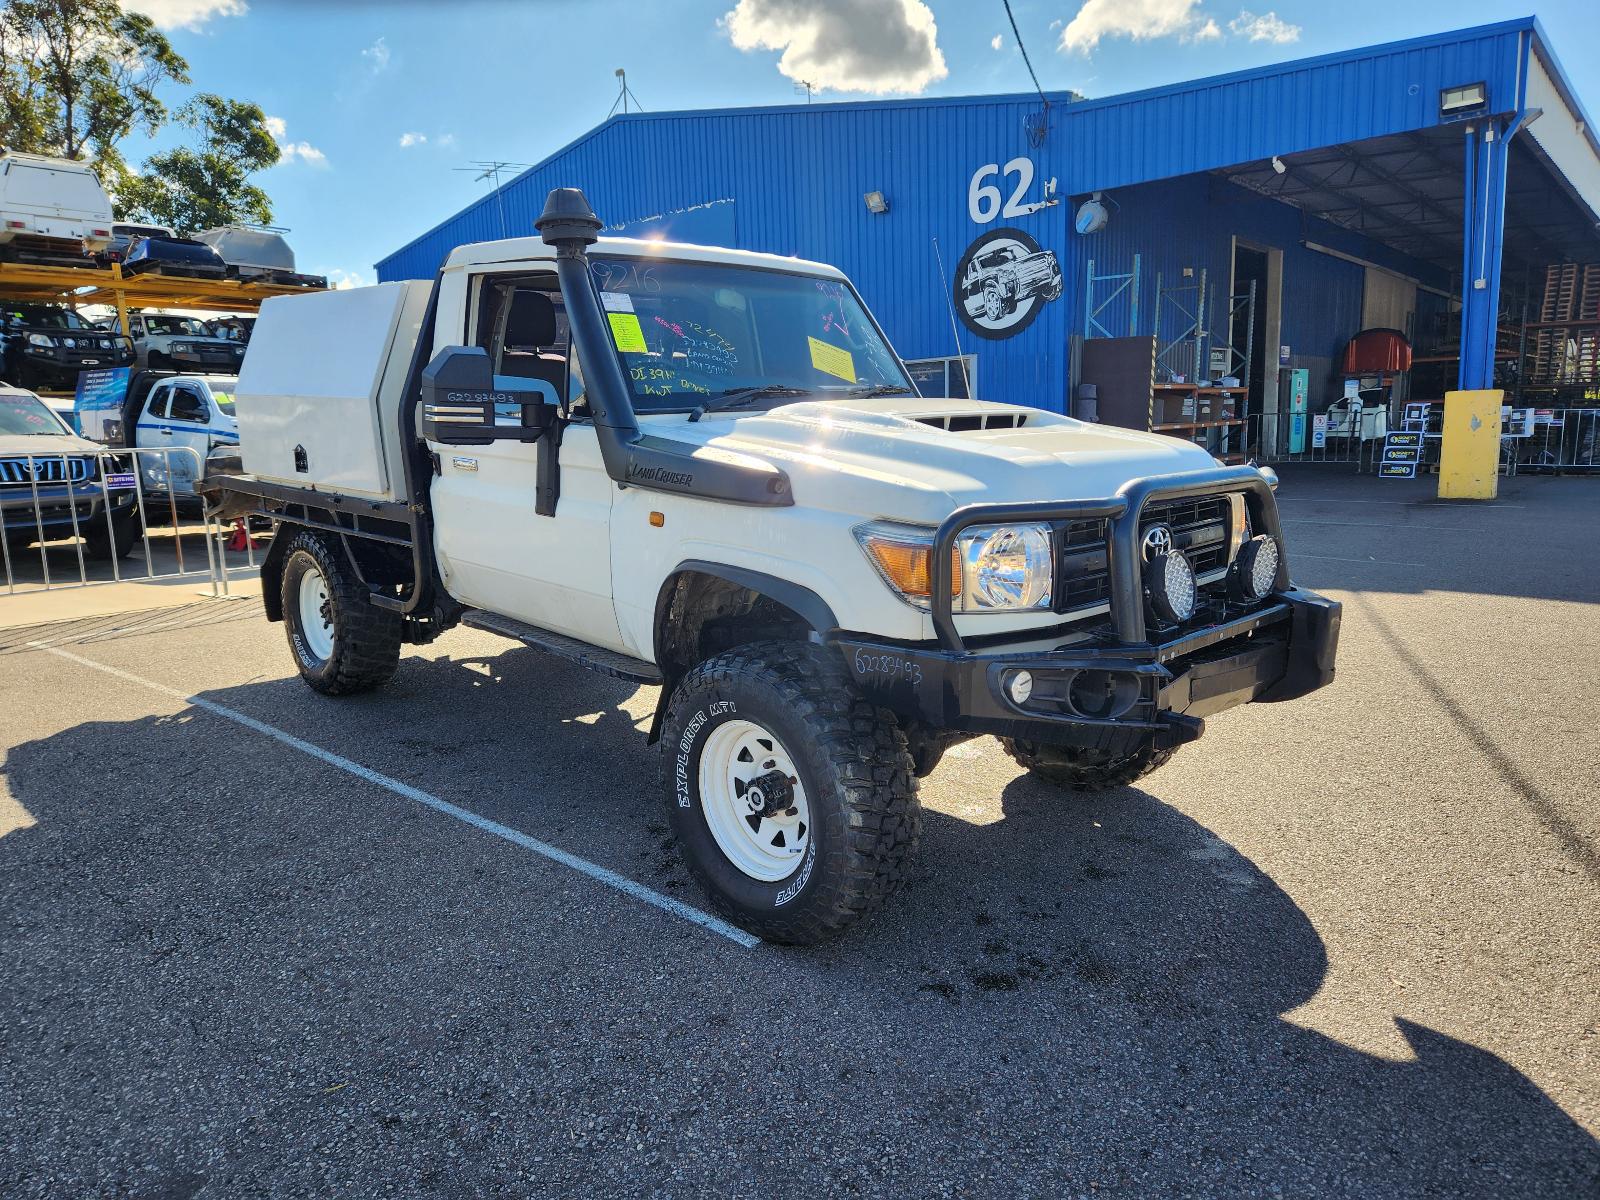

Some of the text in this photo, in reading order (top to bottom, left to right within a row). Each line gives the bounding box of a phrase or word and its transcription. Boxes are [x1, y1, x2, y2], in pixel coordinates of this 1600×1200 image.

[968, 157, 1038, 224] 62
[590, 261, 661, 292] 9216
[676, 710, 708, 808] EXPLORER
